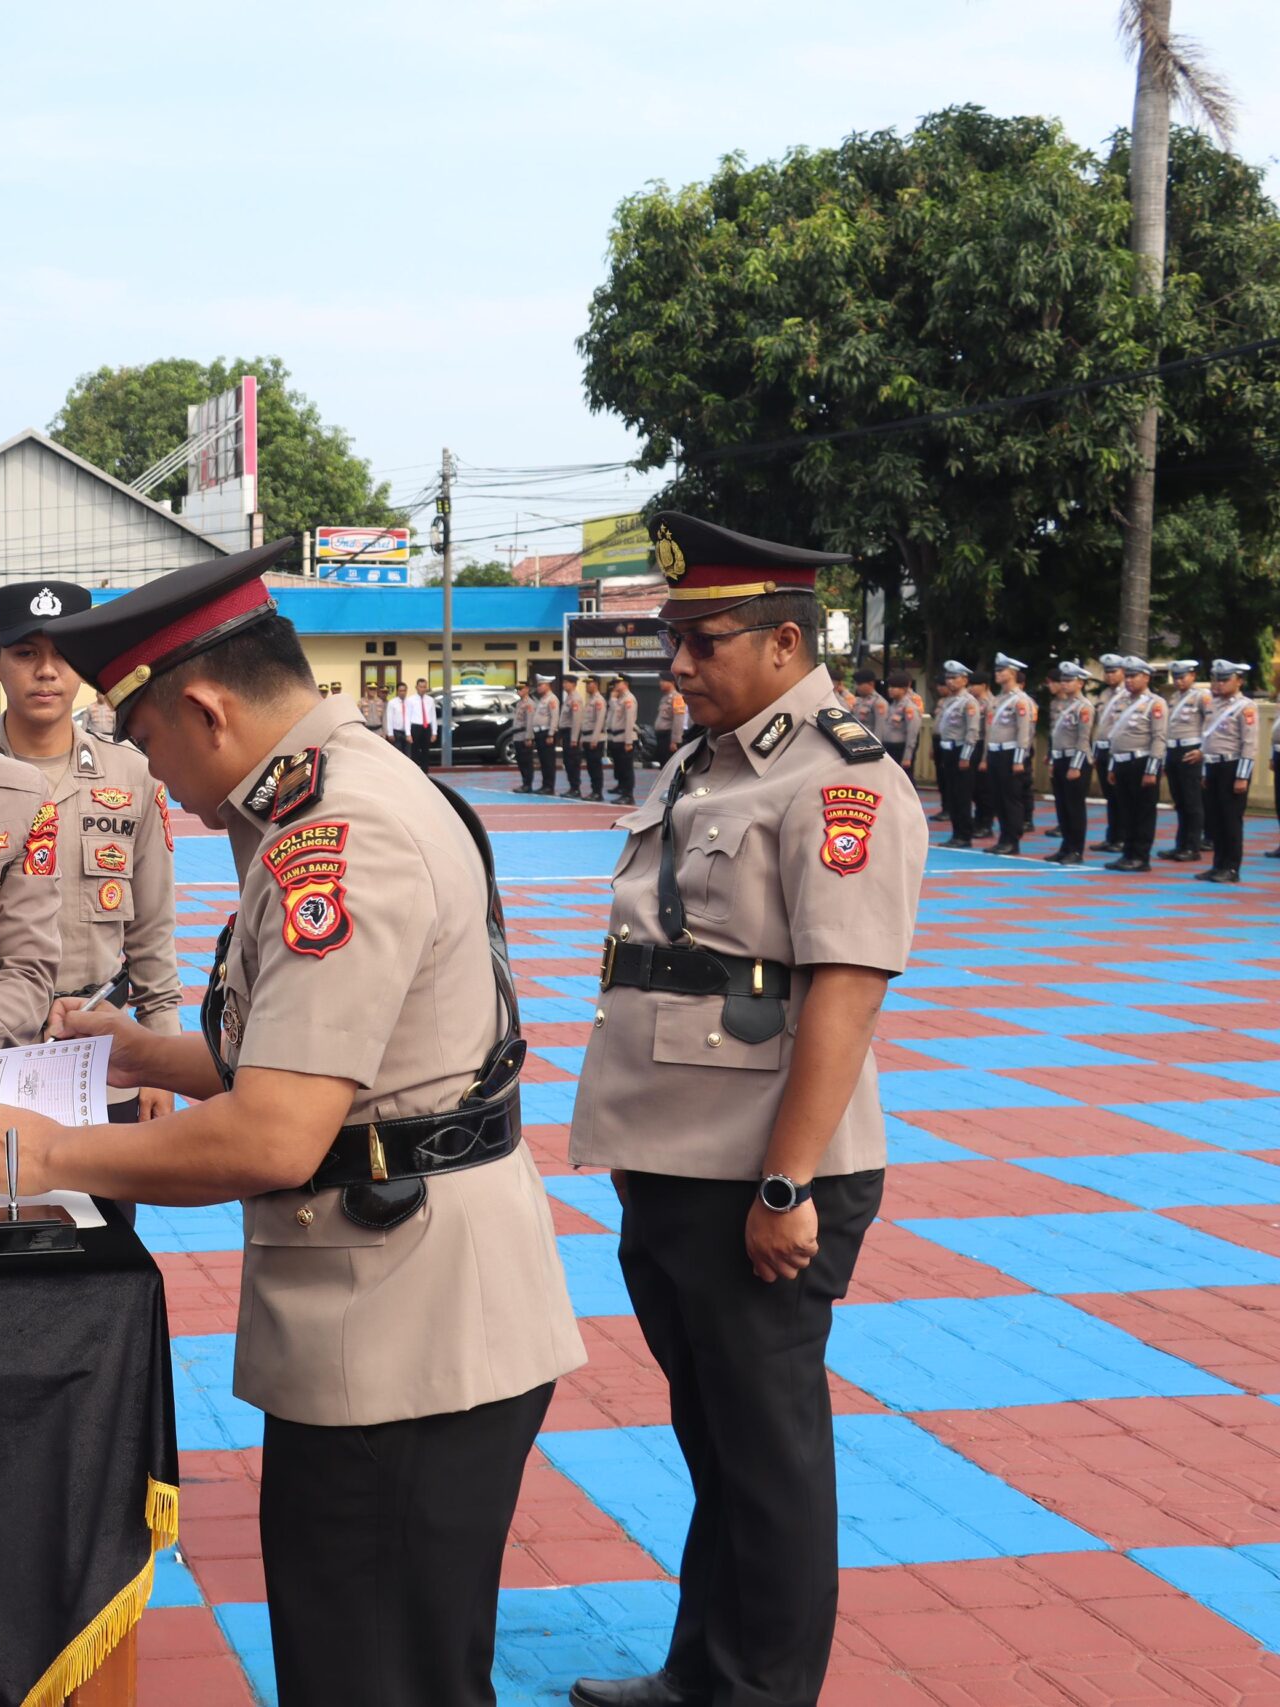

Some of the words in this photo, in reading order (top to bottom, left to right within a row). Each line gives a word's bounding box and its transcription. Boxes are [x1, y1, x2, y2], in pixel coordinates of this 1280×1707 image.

[828, 789, 875, 804] POLDA
[828, 809, 848, 818] JAWA
[848, 810, 873, 822] BARAT
[82, 816, 136, 836] POLRI
[269, 826, 339, 860] POLRES
[273, 838, 338, 866] MAJALENGKA
[282, 865, 307, 883] JAWA
[308, 863, 340, 873] BARAT
